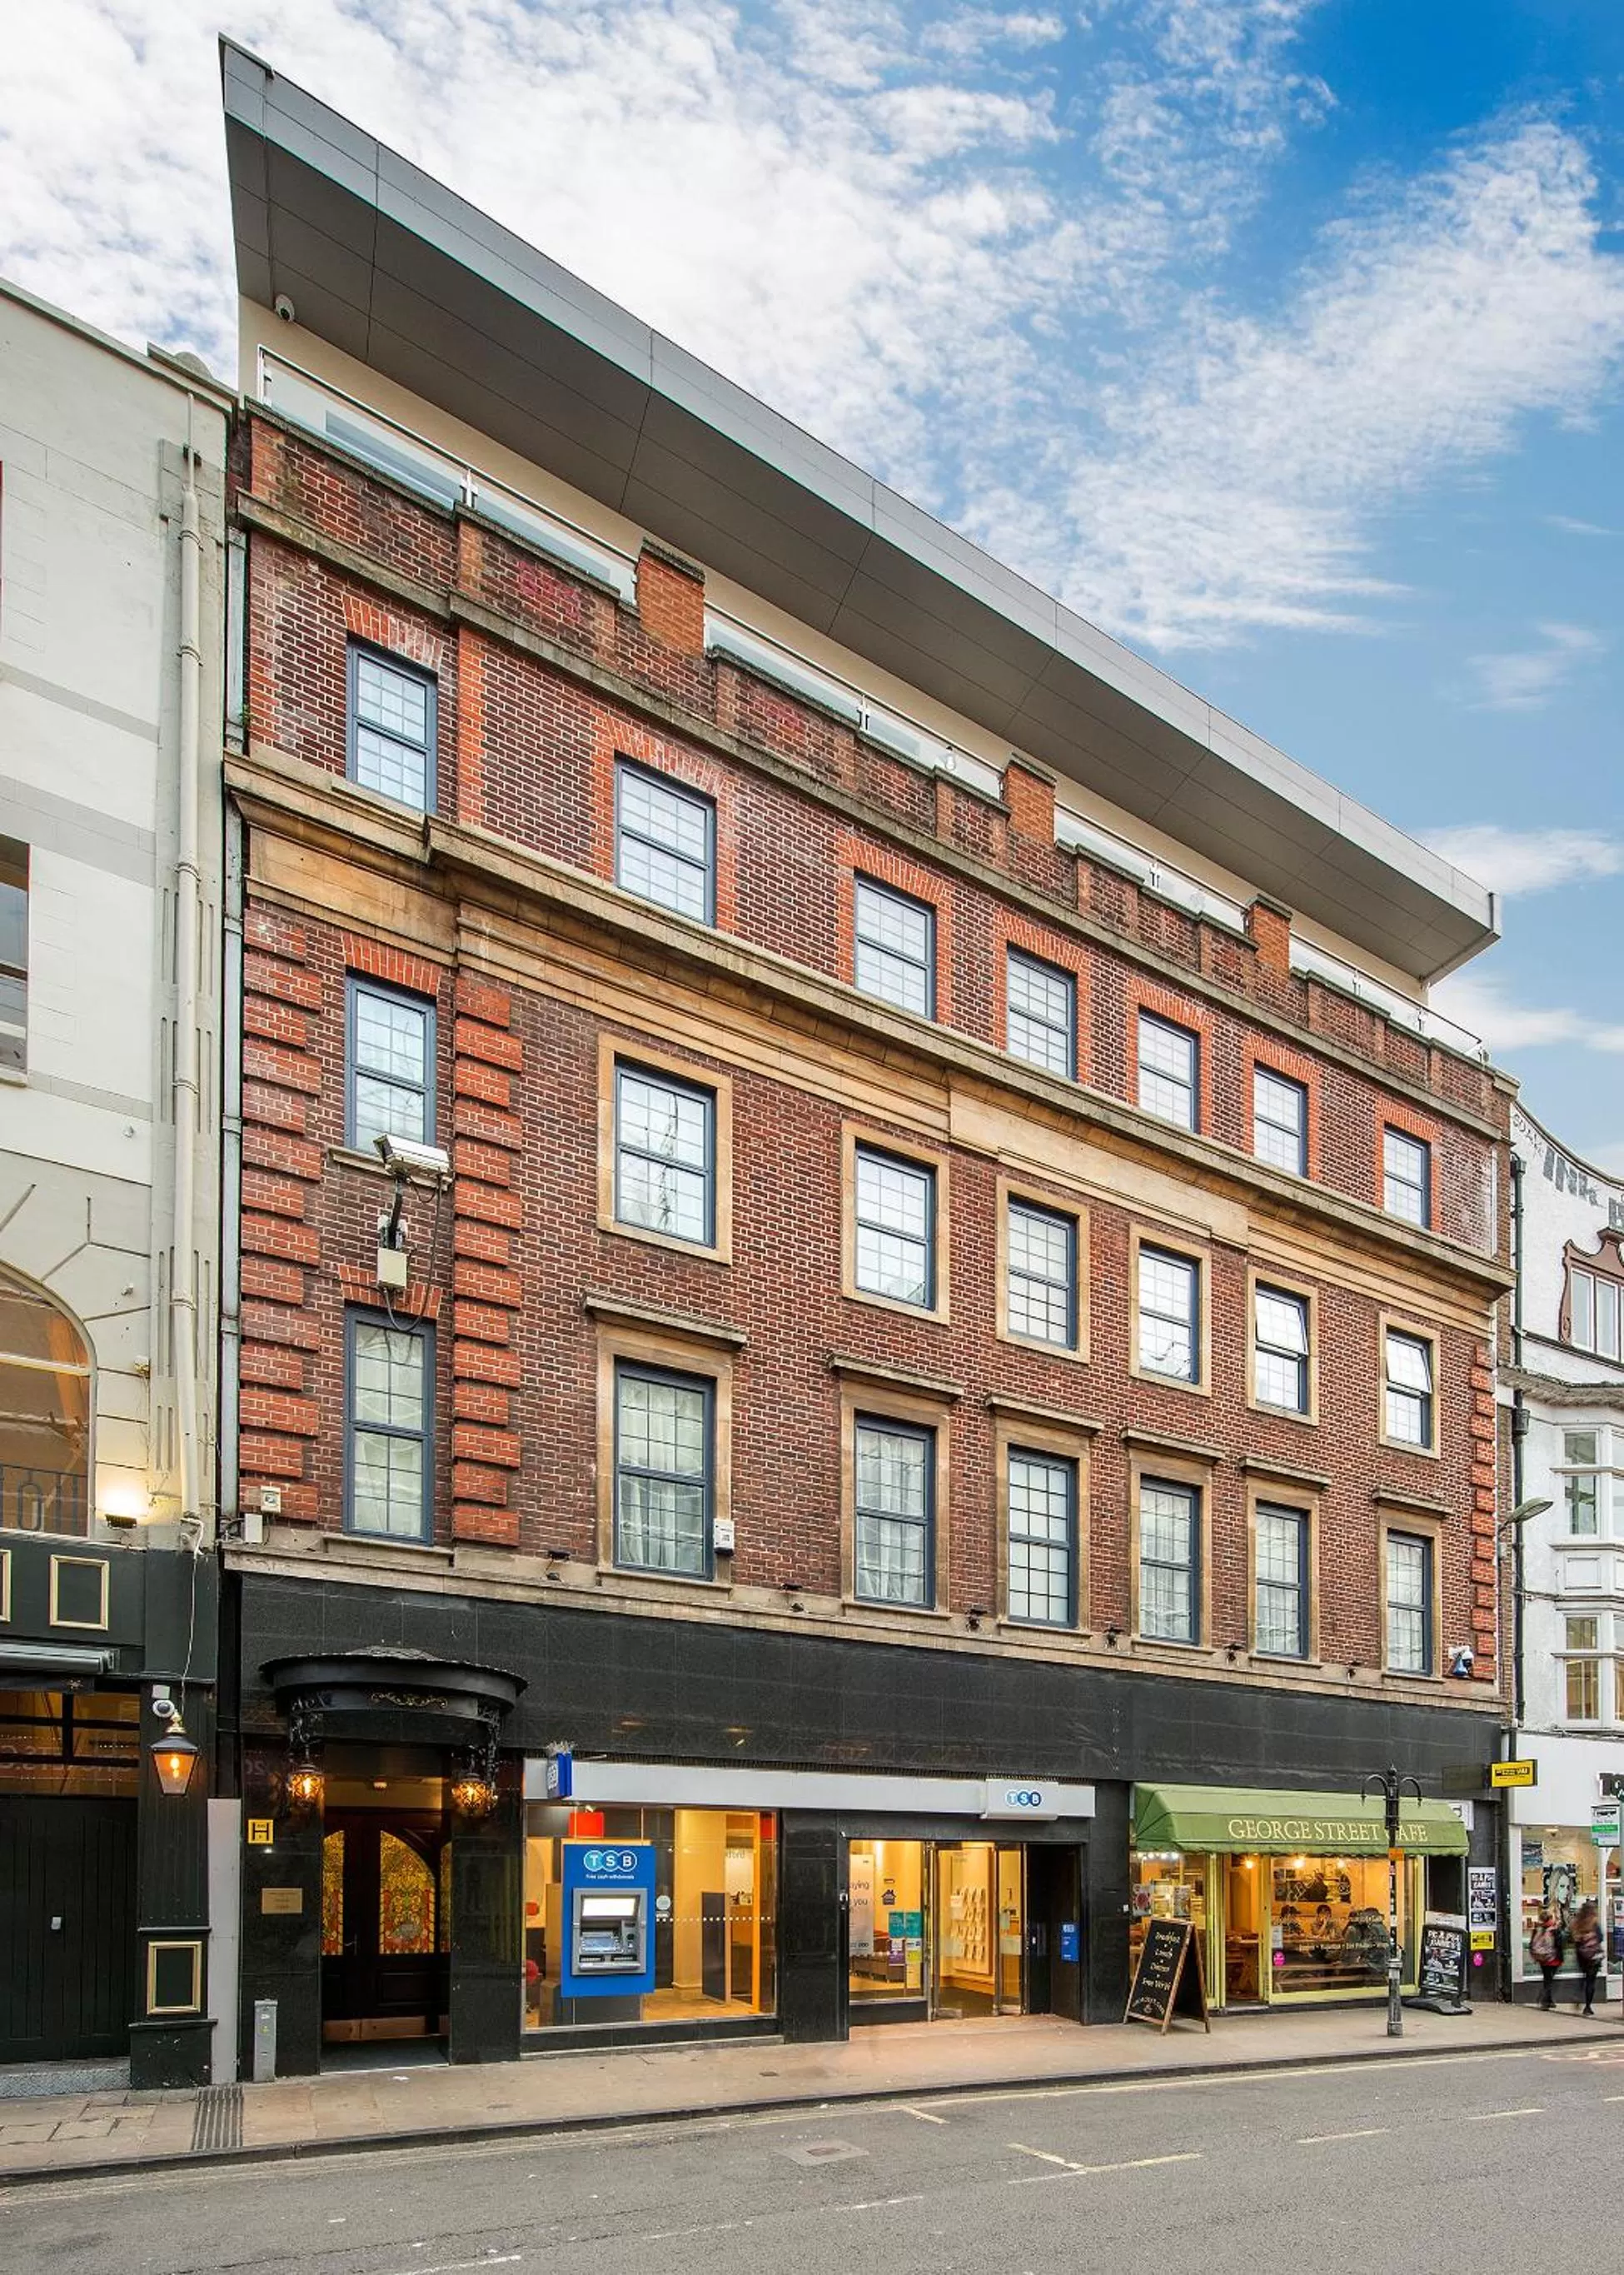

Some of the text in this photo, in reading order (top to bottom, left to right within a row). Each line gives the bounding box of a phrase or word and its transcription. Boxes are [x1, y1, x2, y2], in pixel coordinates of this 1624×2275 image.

[1007, 1793, 1040, 1806] TSB
[1228, 1819, 1313, 1840] GEORGE
[1315, 1821, 1381, 1842] STREET
[588, 1853, 633, 1868] TSB
